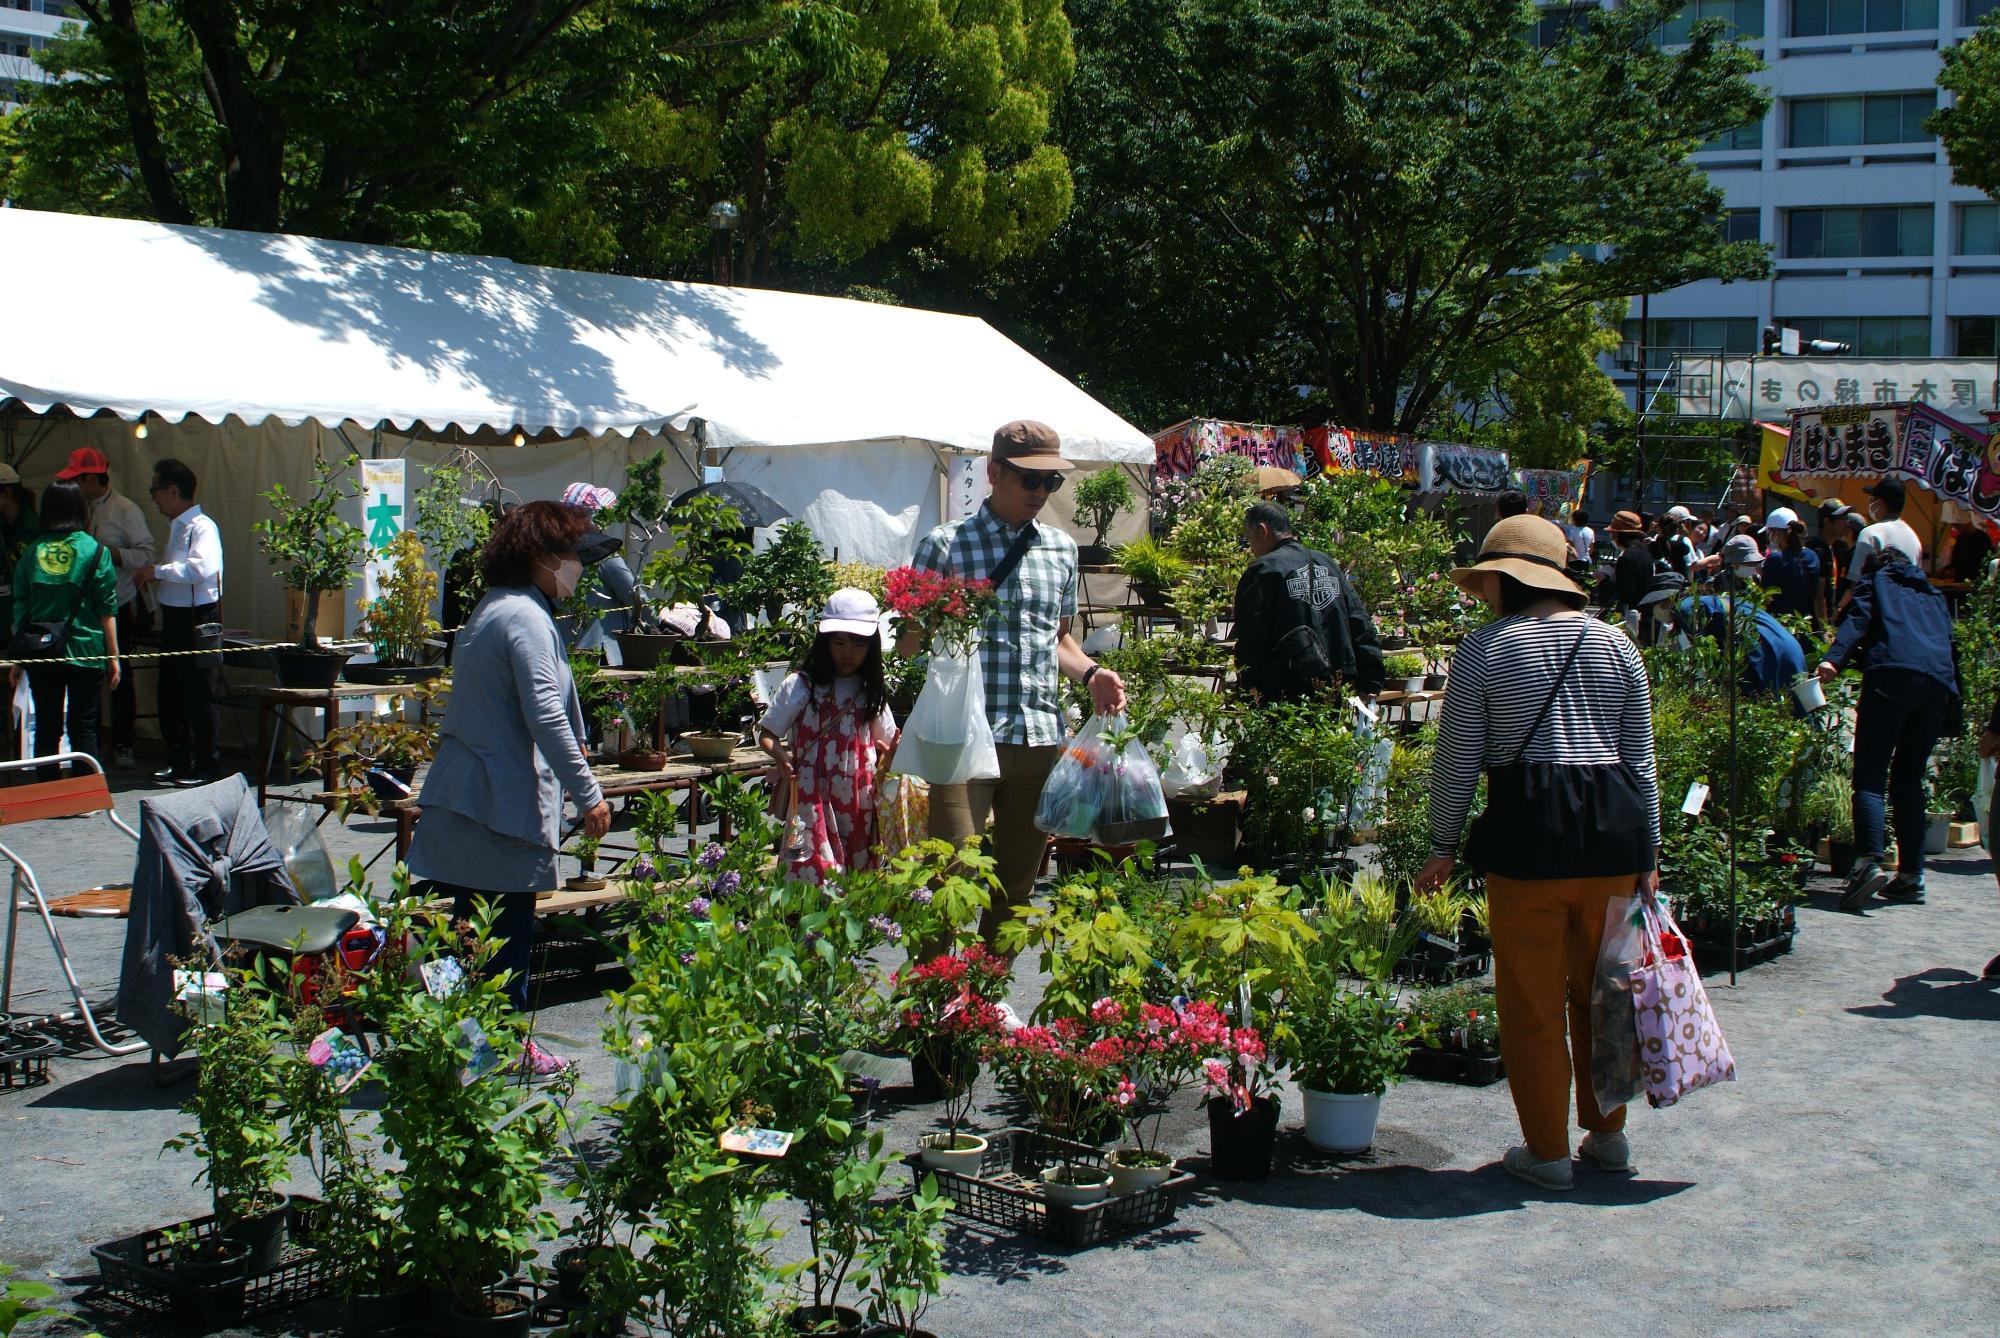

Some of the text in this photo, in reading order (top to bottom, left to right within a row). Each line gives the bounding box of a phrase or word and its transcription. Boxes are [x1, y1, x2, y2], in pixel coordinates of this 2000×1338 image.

[1803, 418, 1892, 473] はしまき
[964, 459, 973, 515] スタン
